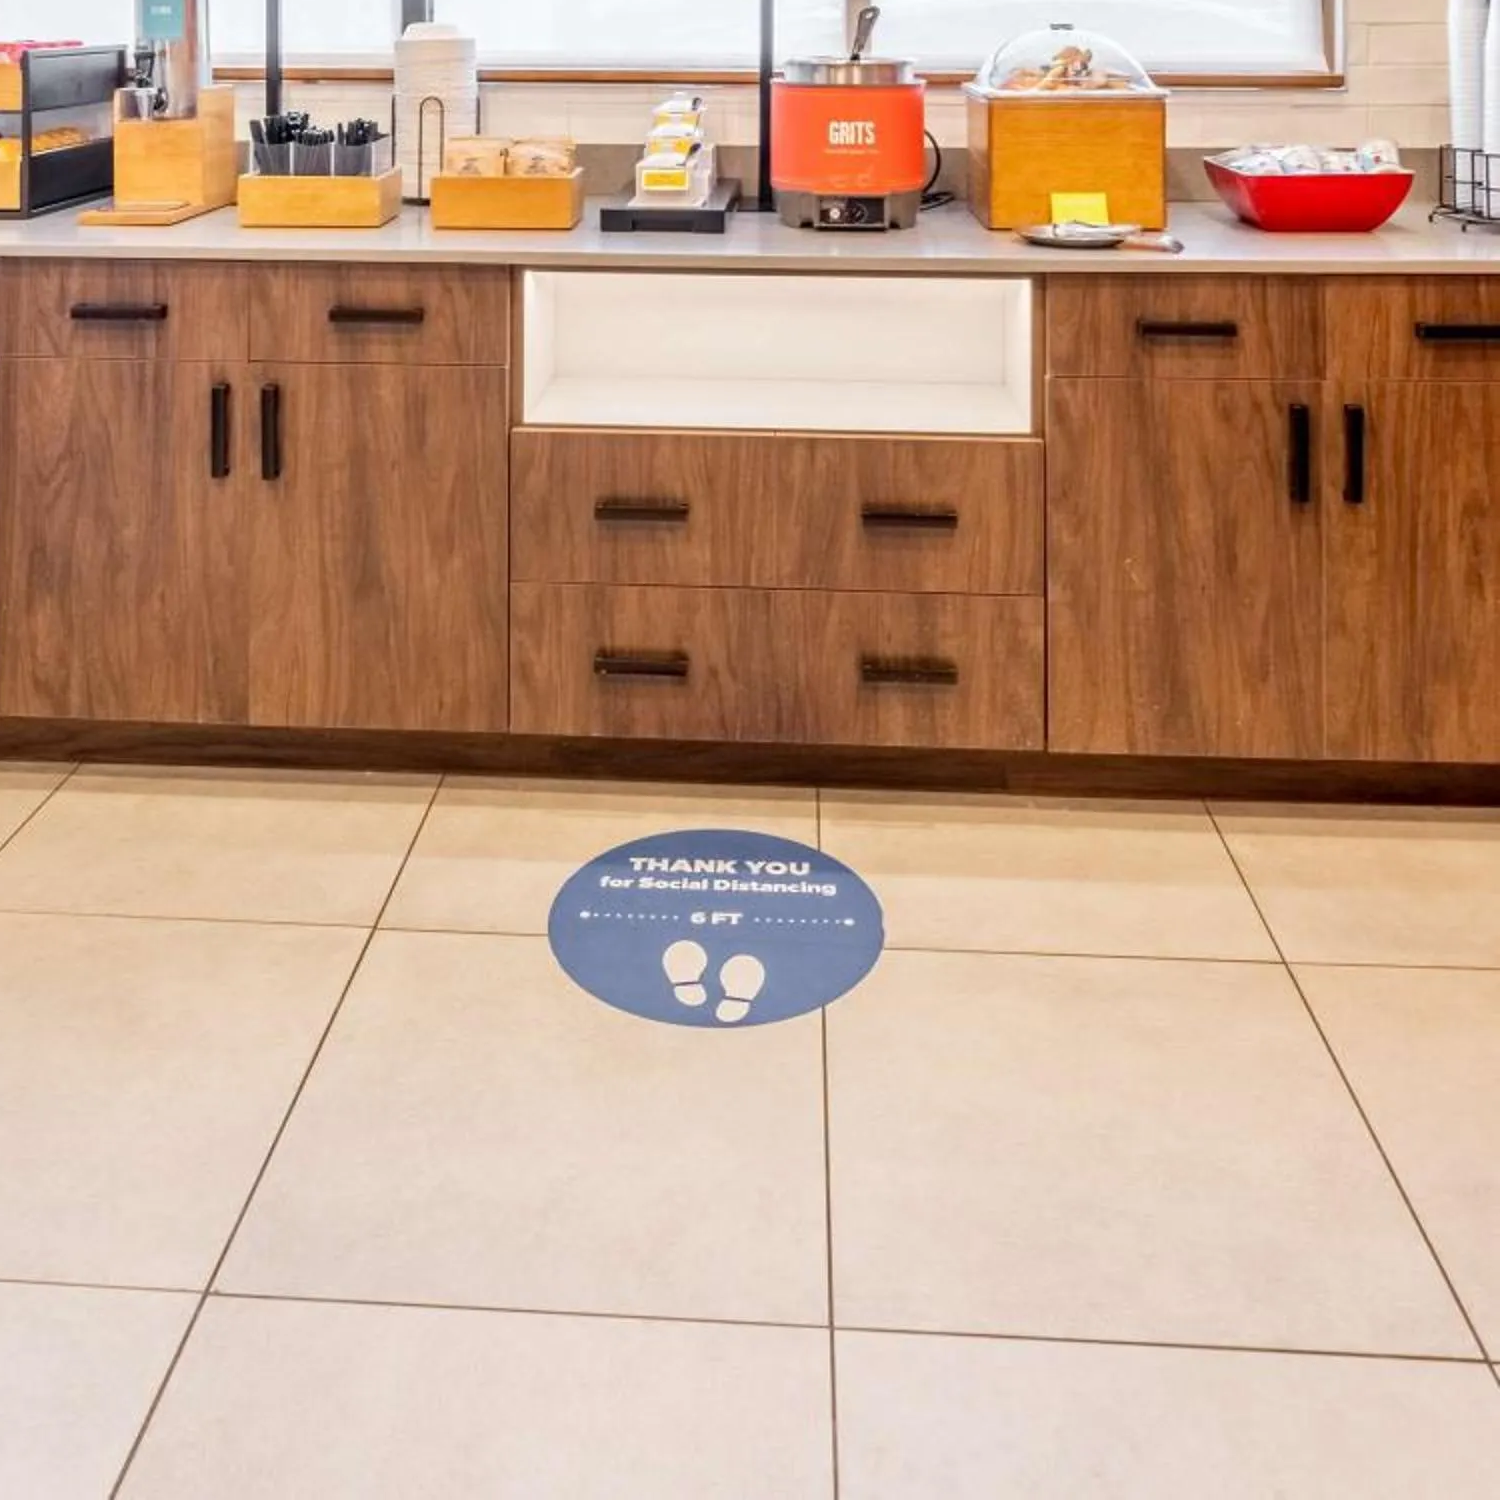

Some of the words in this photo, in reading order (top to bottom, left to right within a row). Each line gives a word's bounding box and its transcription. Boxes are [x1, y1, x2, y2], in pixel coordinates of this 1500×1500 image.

[828, 121, 876, 145] GRITS
[629, 857, 738, 875] THANK
[743, 860, 810, 876] YOU
[600, 876, 634, 889] for
[638, 877, 708, 891] Social
[713, 879, 837, 897] Distancing
[690, 911, 707, 925] 6
[711, 912, 744, 925] FT
